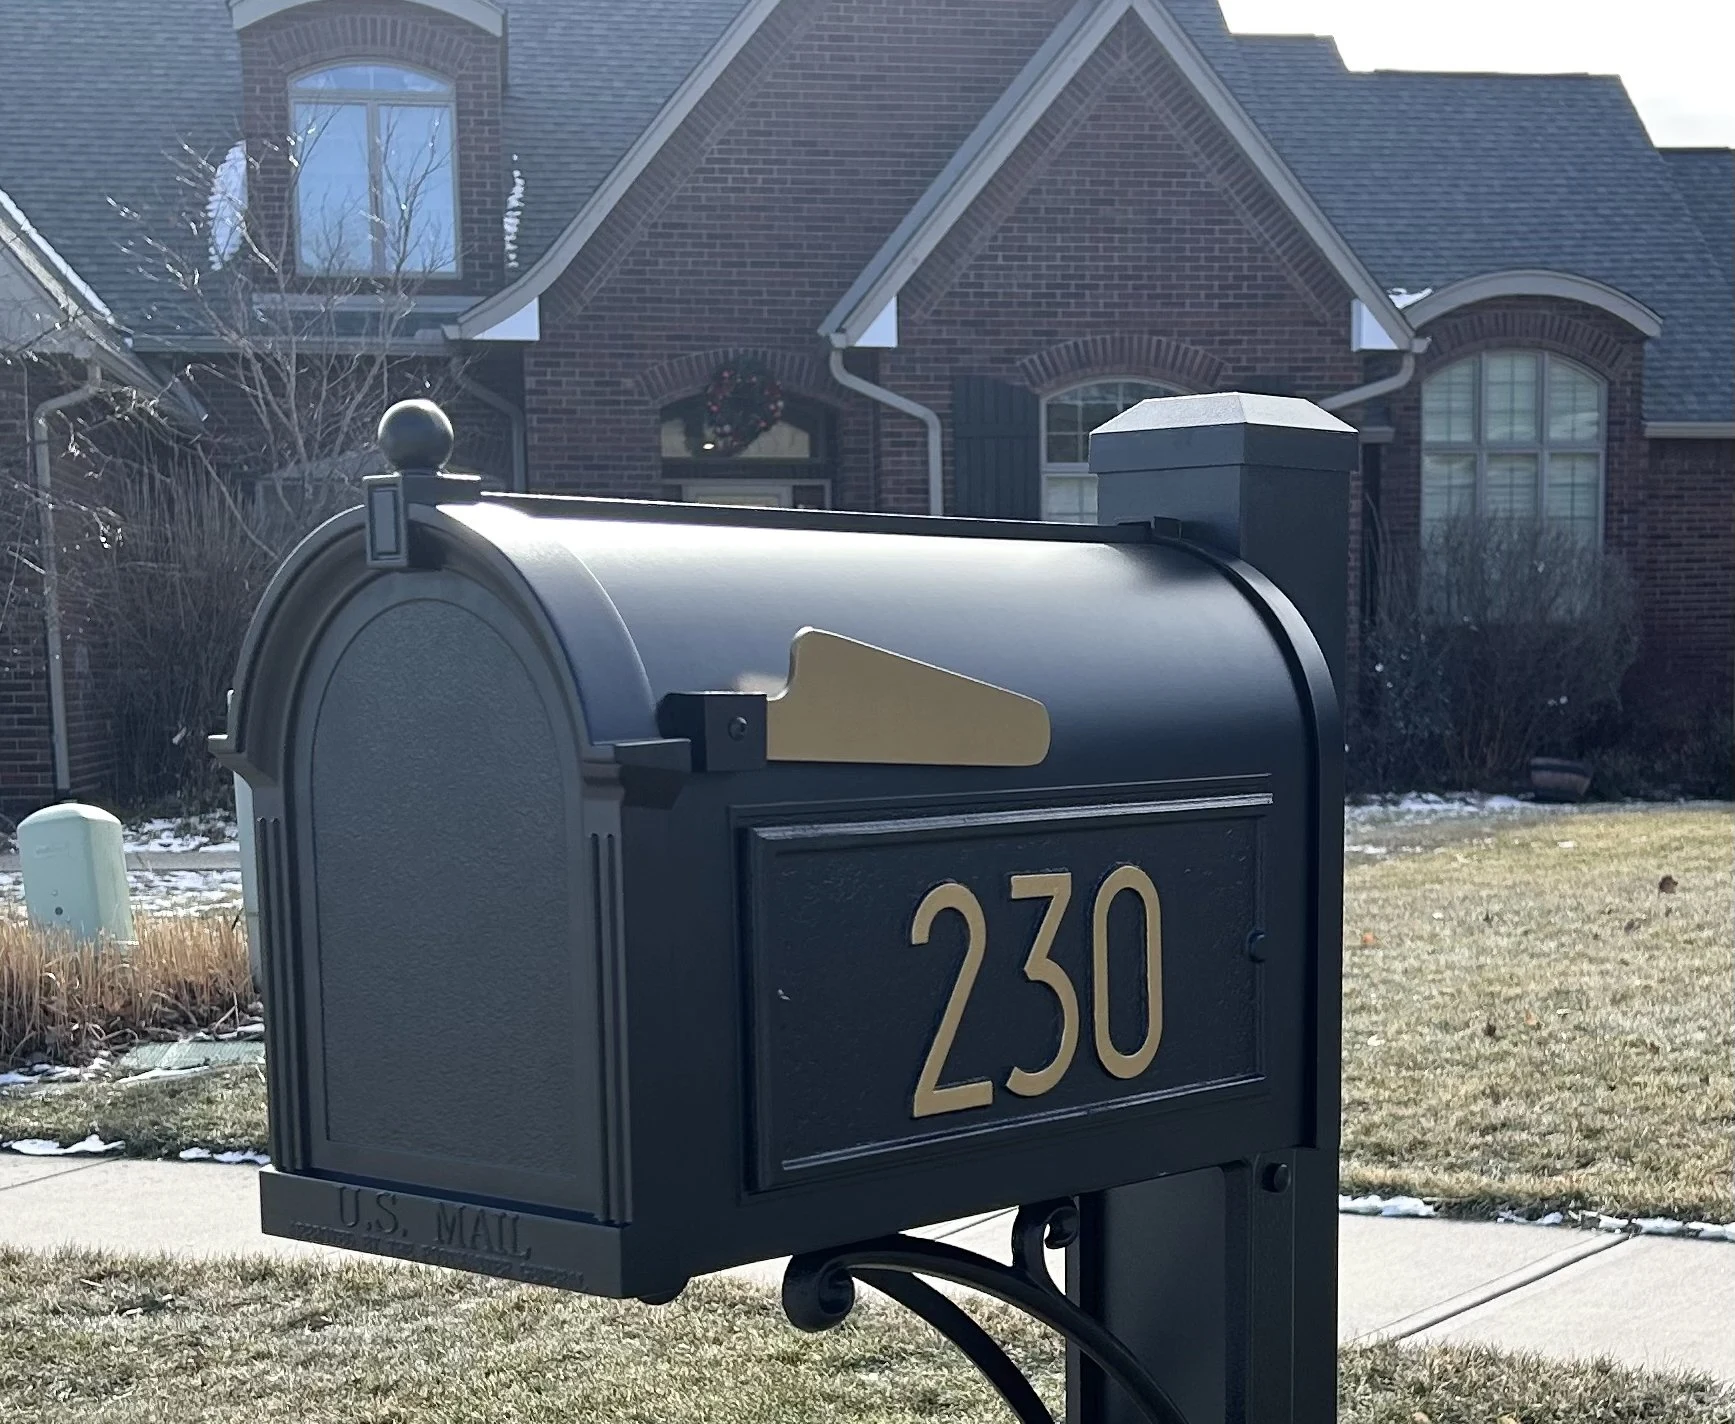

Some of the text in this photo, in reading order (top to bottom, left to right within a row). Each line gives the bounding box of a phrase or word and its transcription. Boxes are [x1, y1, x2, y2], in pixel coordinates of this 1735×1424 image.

[911, 864, 1163, 1118] 230
[337, 1186, 407, 1238] U.S.
[436, 1201, 532, 1260] MAIL
